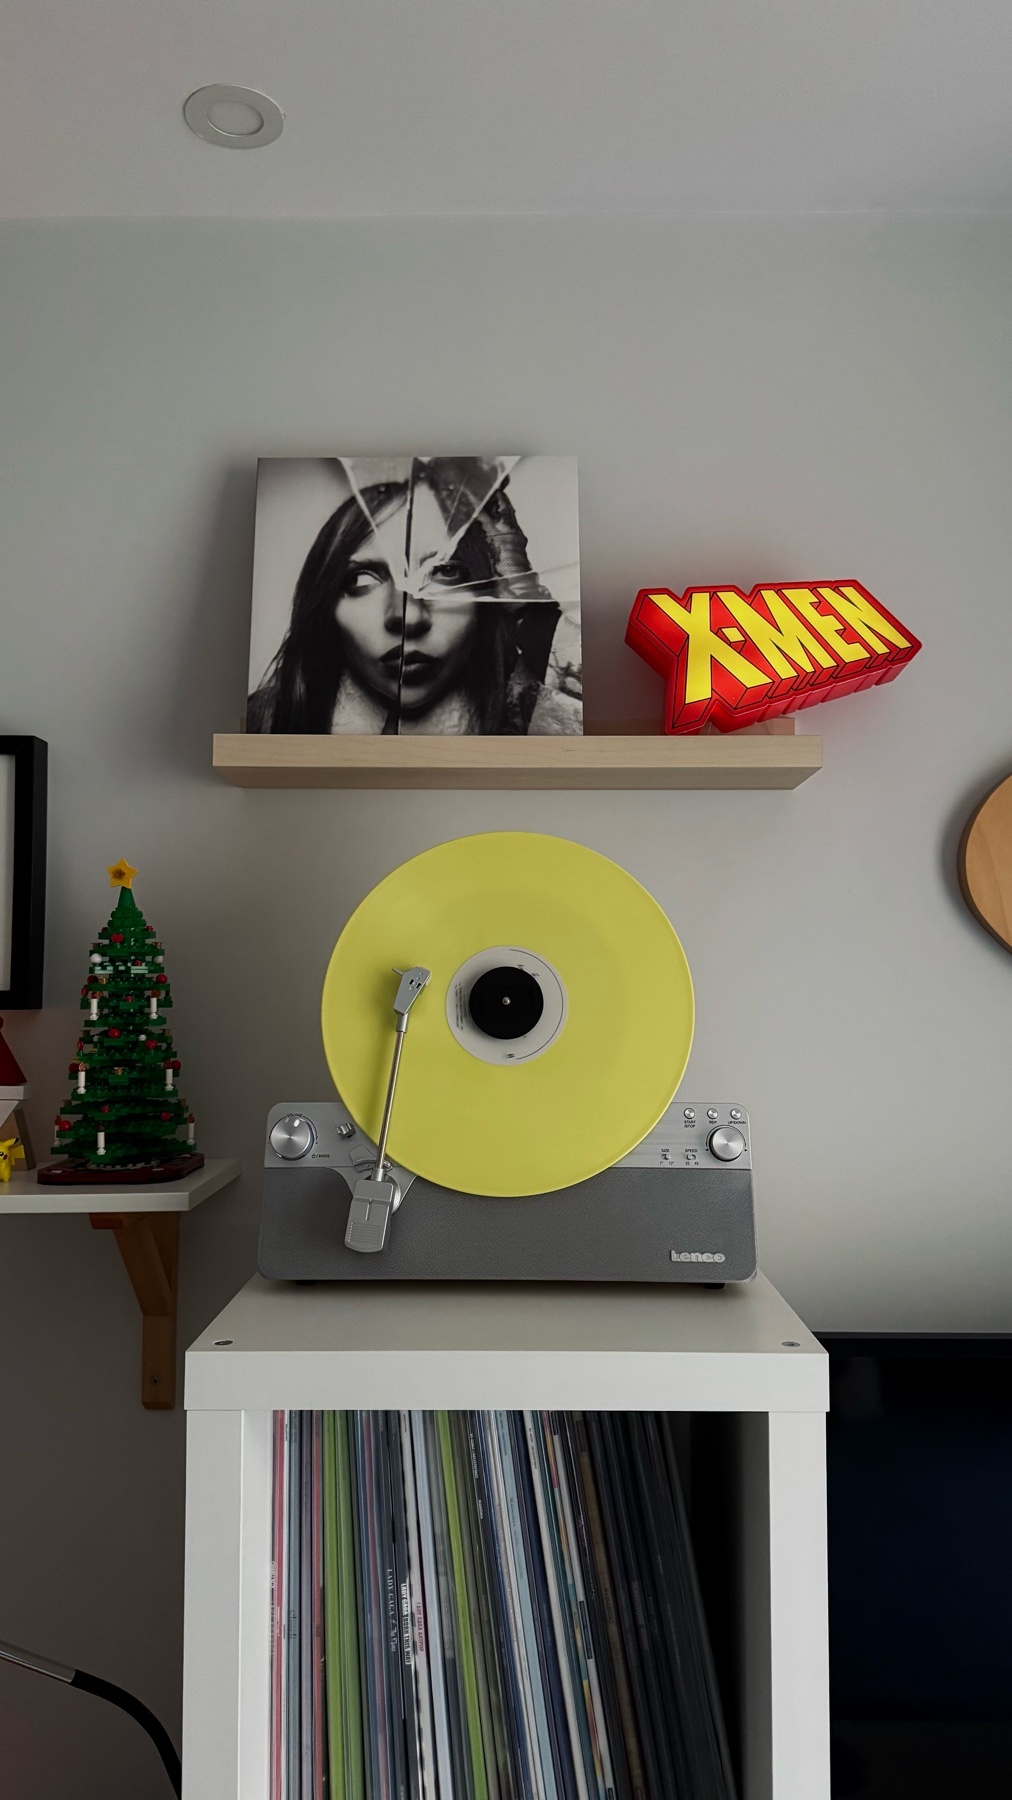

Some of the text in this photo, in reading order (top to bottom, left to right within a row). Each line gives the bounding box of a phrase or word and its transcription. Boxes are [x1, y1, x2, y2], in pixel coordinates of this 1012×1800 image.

[647, 585, 913, 705] X-MEN
[386, 1569, 395, 1590] LADY
[400, 1583, 408, 1598] LADY
[388, 1593, 396, 1615] GAGA
[401, 1598, 409, 1616] GAGA
[403, 1635, 411, 1650] THIS
[404, 1650, 412, 1665] WAY
